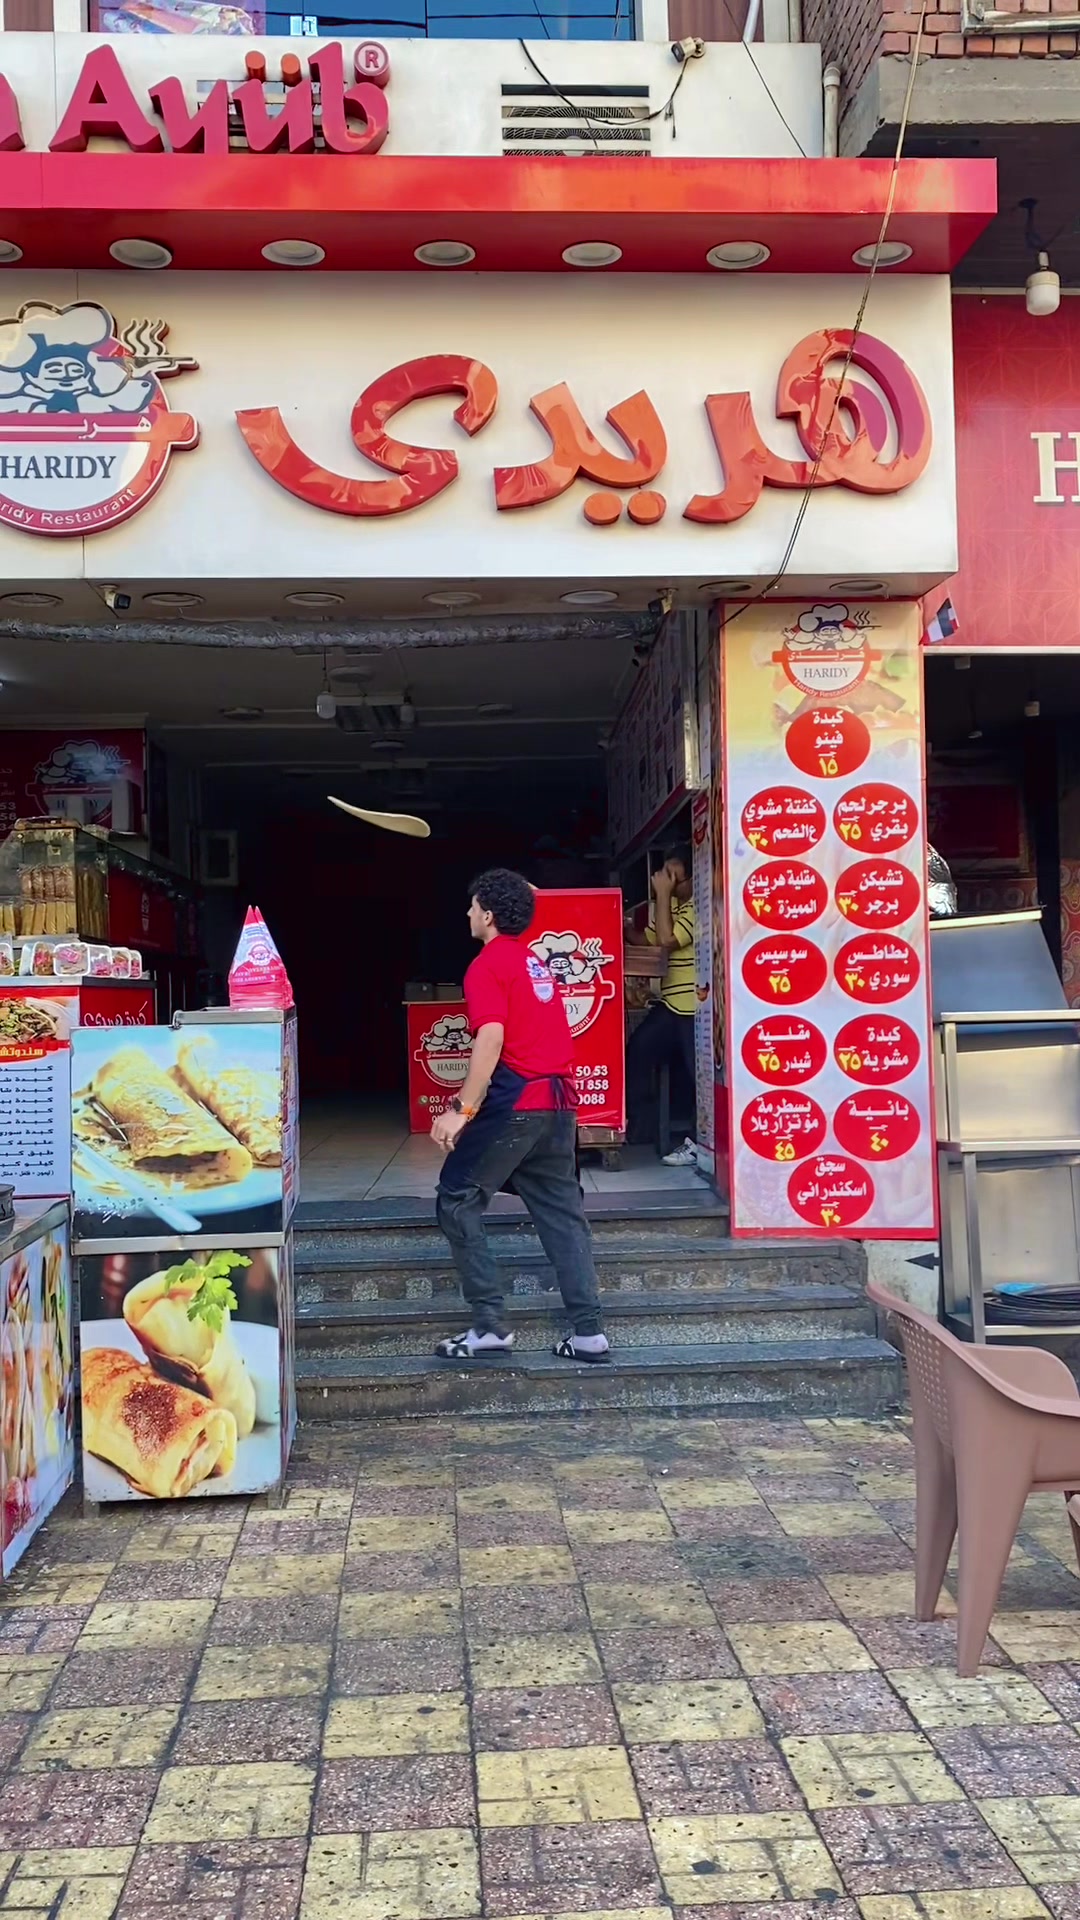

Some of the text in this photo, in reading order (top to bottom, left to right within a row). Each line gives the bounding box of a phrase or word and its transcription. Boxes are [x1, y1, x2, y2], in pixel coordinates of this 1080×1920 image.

[1, 455, 117, 479] HARIDY
[41, 487, 136, 525] Restaurant
[804, 667, 849, 678] HARIDY
[813, 710, 844, 727] كبدة
[814, 731, 844, 749] فينو
[818, 758, 838, 775] ١٥
[745, 798, 817, 822] كفتة مشوي
[840, 822, 862, 841] ٢٥
[870, 819, 908, 842] بقري
[788, 870, 816, 890] مقلية
[859, 870, 903, 890] تشيكن
[778, 899, 817, 918] المميزة
[847, 944, 909, 964] بطاطس
[769, 974, 791, 993] ٢٥
[869, 972, 910, 990] سوري
[757, 1024, 811, 1044] مقلية
[867, 1026, 901, 1045] كبدة
[757, 1052, 780, 1072] ٢٥
[783, 1051, 811, 1073] شيدر
[839, 1052, 862, 1071] ٢٥
[863, 1049, 909, 1071] مشوية
[756, 1097, 812, 1117] بسطرمة
[848, 1101, 909, 1121] بانية
[775, 1141, 795, 1160] ٤٥
[815, 1157, 846, 1176] سجق
[797, 1181, 867, 1205] اسكندراني
